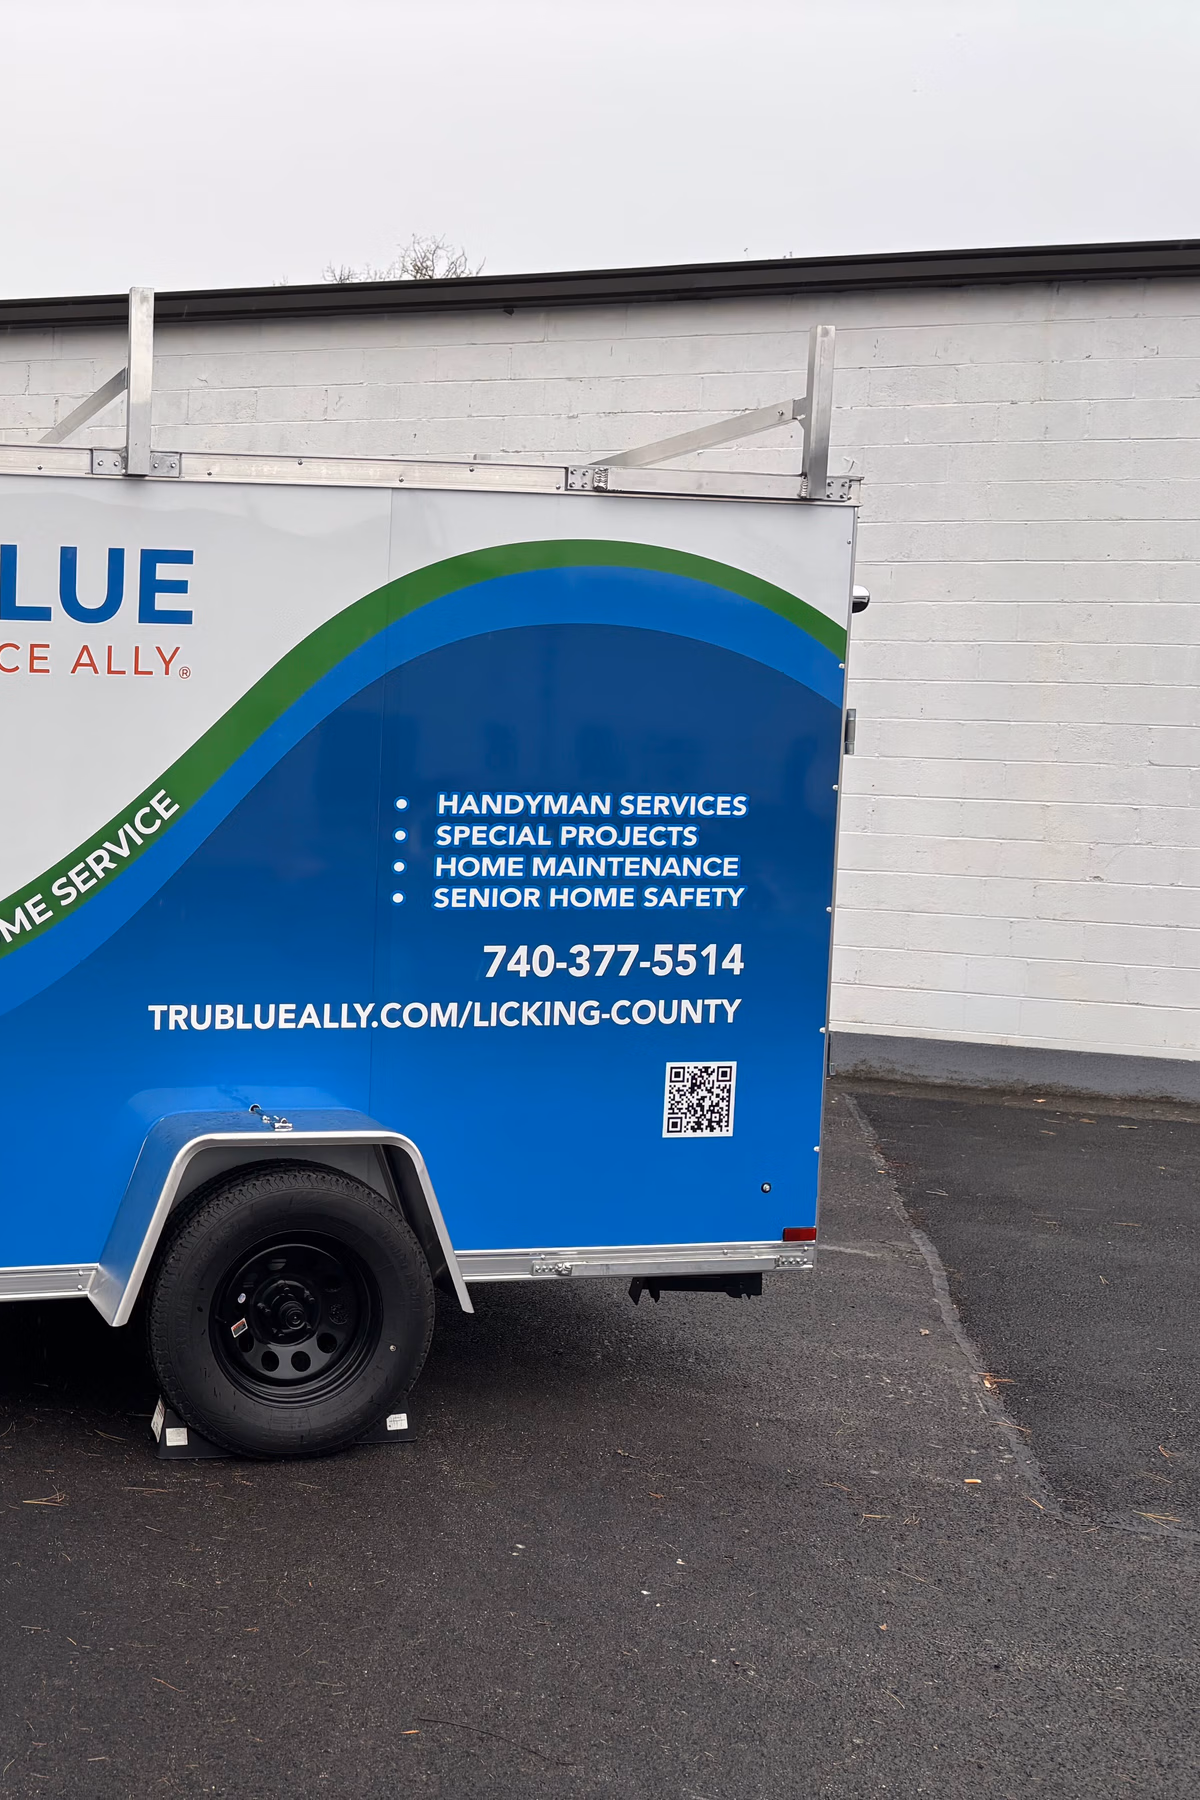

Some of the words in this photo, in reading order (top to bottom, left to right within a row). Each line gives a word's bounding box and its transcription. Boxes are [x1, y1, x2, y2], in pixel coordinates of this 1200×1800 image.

[438, 794, 611, 815] HANDYMAN
[620, 794, 747, 816] SERVICES
[436, 825, 552, 846] SPECIAL
[560, 825, 698, 847] PROJECTS
[51, 788, 181, 907] SERVICE
[435, 856, 524, 877] HOME
[532, 857, 739, 877] MAINTENANCE
[434, 887, 541, 909] SENIOR
[549, 887, 635, 908] HOME
[643, 887, 745, 908] SAFETY
[483, 943, 745, 978] 740-377-5514
[147, 998, 742, 1031] TRUBLUEALLY.COM/LICKING-COUNTY
